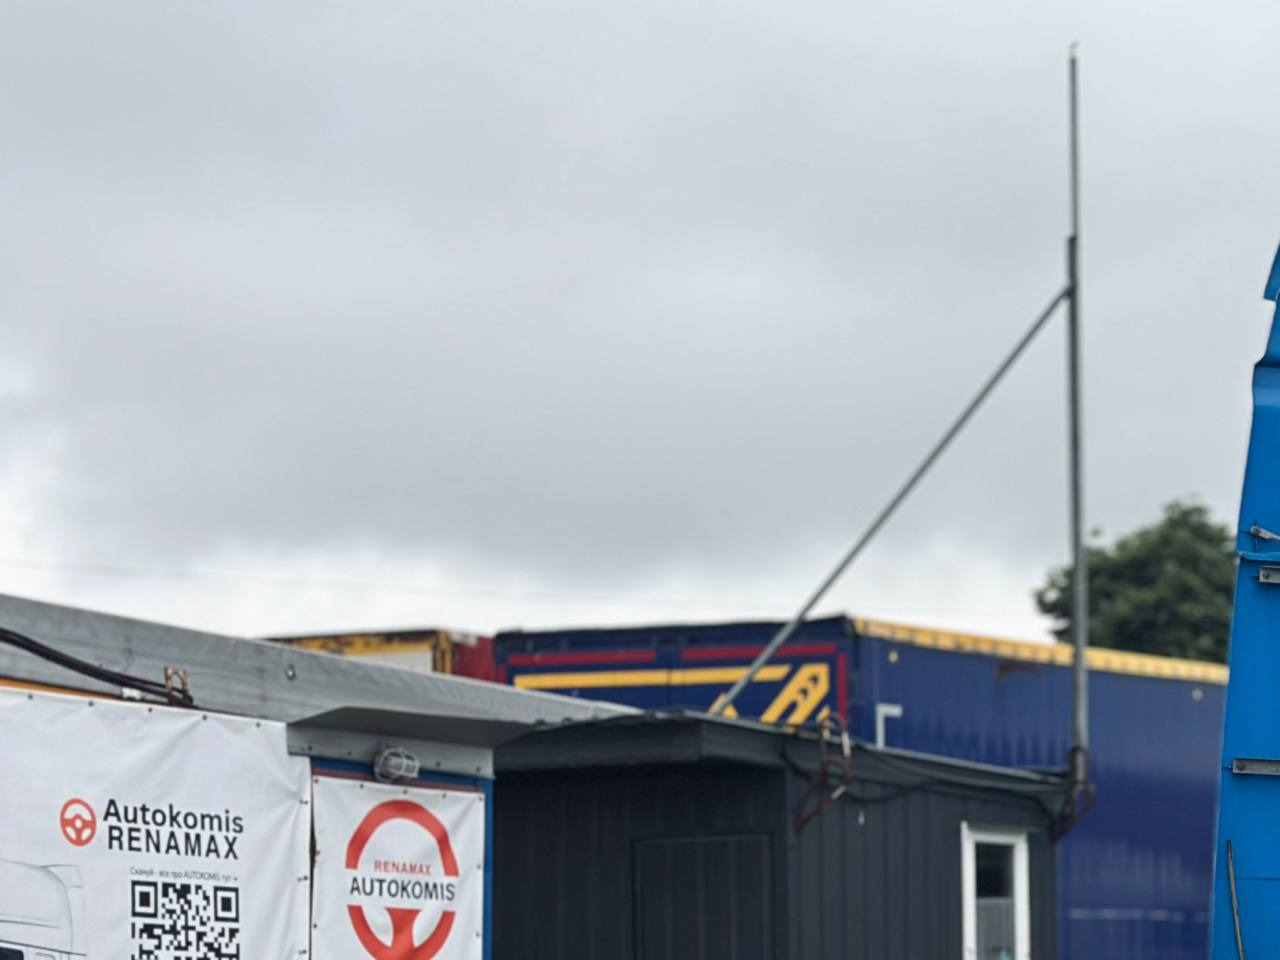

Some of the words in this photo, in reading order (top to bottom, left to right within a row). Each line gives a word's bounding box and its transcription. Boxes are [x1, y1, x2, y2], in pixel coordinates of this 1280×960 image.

[103, 798, 244, 833] Autokomis
[108, 825, 239, 860] RENAMAX
[374, 860, 432, 875] RENAMAX
[350, 876, 455, 901] AUTOKOMIS
